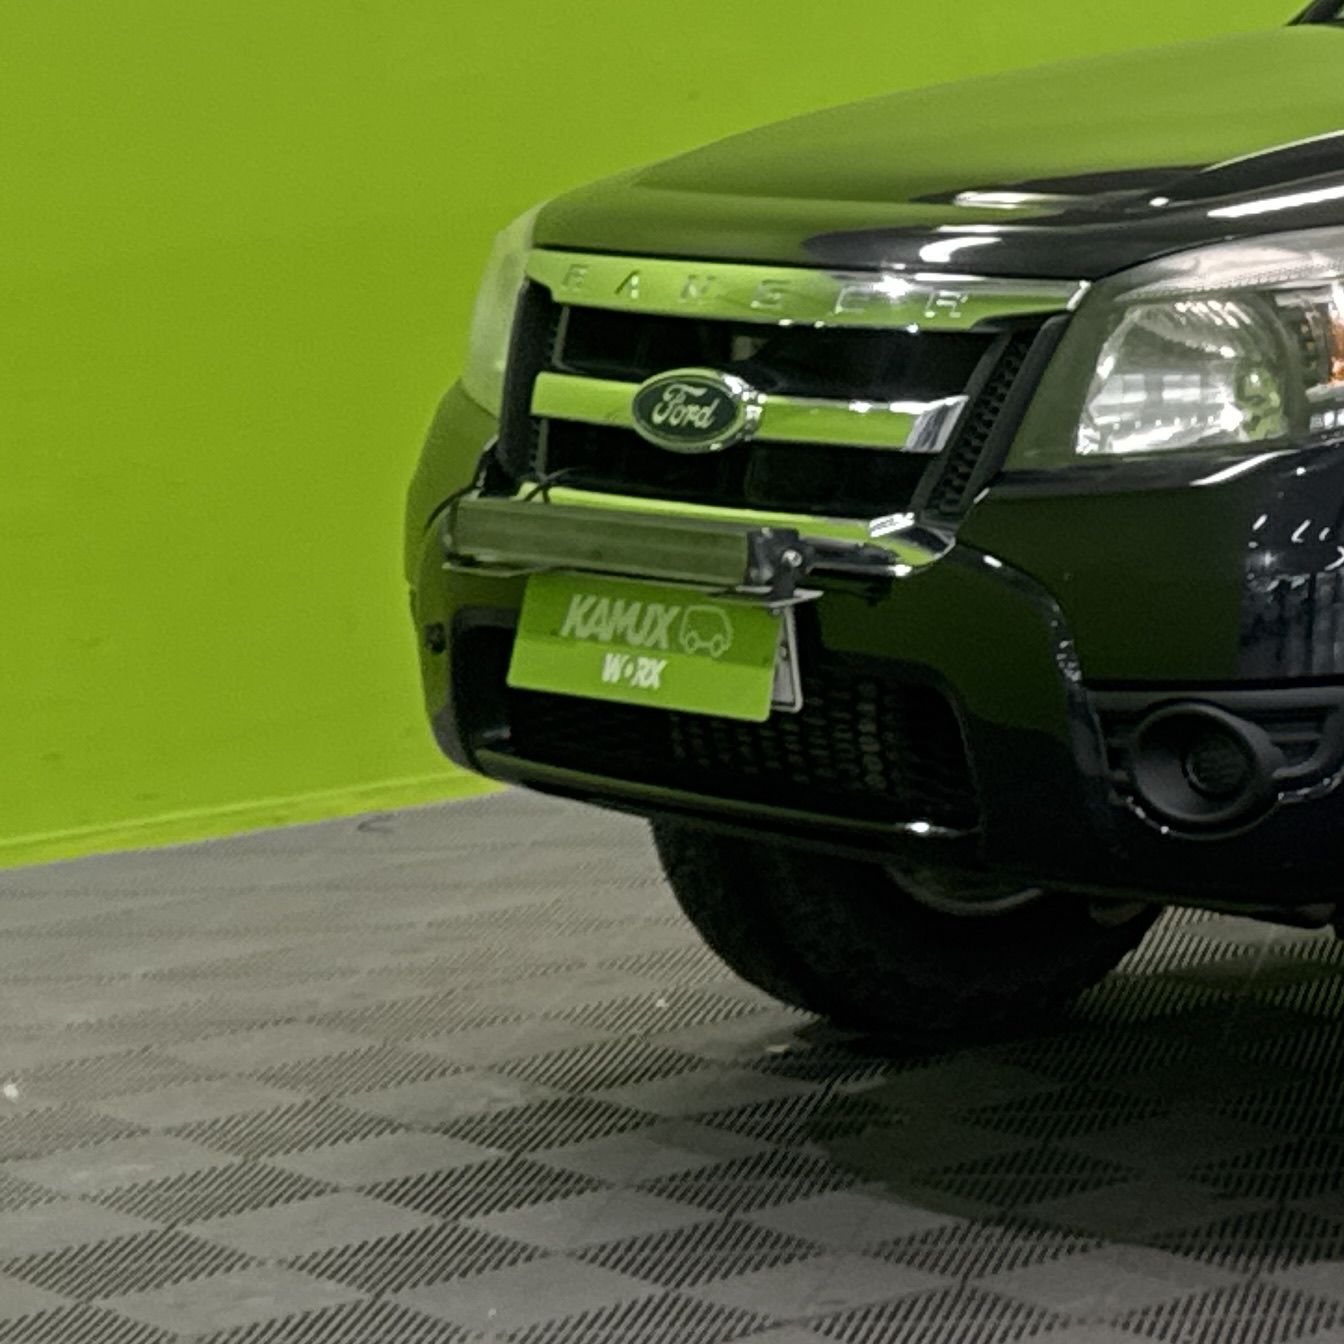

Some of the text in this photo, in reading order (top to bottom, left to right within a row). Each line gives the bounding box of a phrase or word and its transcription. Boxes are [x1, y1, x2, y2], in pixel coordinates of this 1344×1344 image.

[560, 262, 969, 318] RANGER
[651, 383, 720, 430] Ford
[560, 593, 680, 649] KAMUX
[601, 652, 667, 690] WORX
